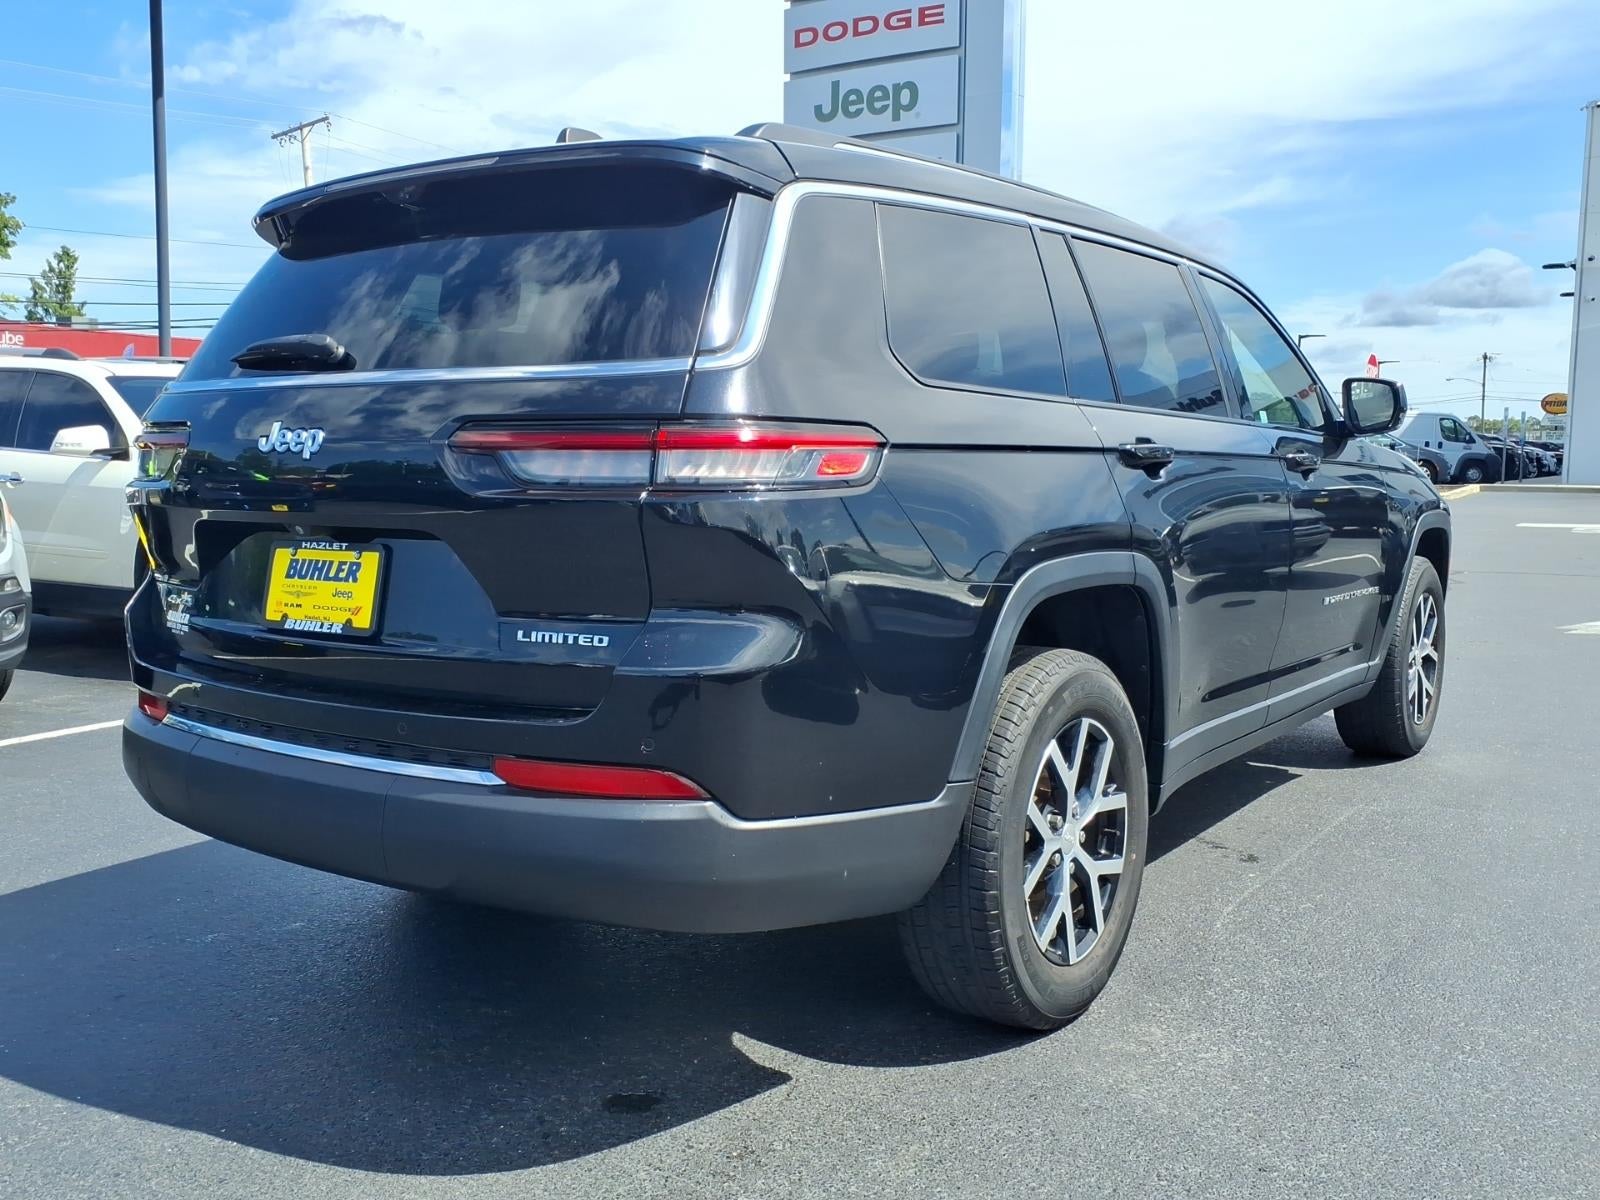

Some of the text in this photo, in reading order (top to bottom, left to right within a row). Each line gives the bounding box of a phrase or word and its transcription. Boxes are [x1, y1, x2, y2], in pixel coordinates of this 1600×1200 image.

[794, 4, 945, 48] DODGE
[813, 80, 919, 122] Jeep
[257, 421, 325, 459] Jeep
[301, 541, 349, 550] HAZLET
[285, 558, 362, 583] BUHLER
[331, 588, 353, 600] Jeep
[284, 619, 344, 634] BUHLER
[517, 630, 609, 647] LIMITED
